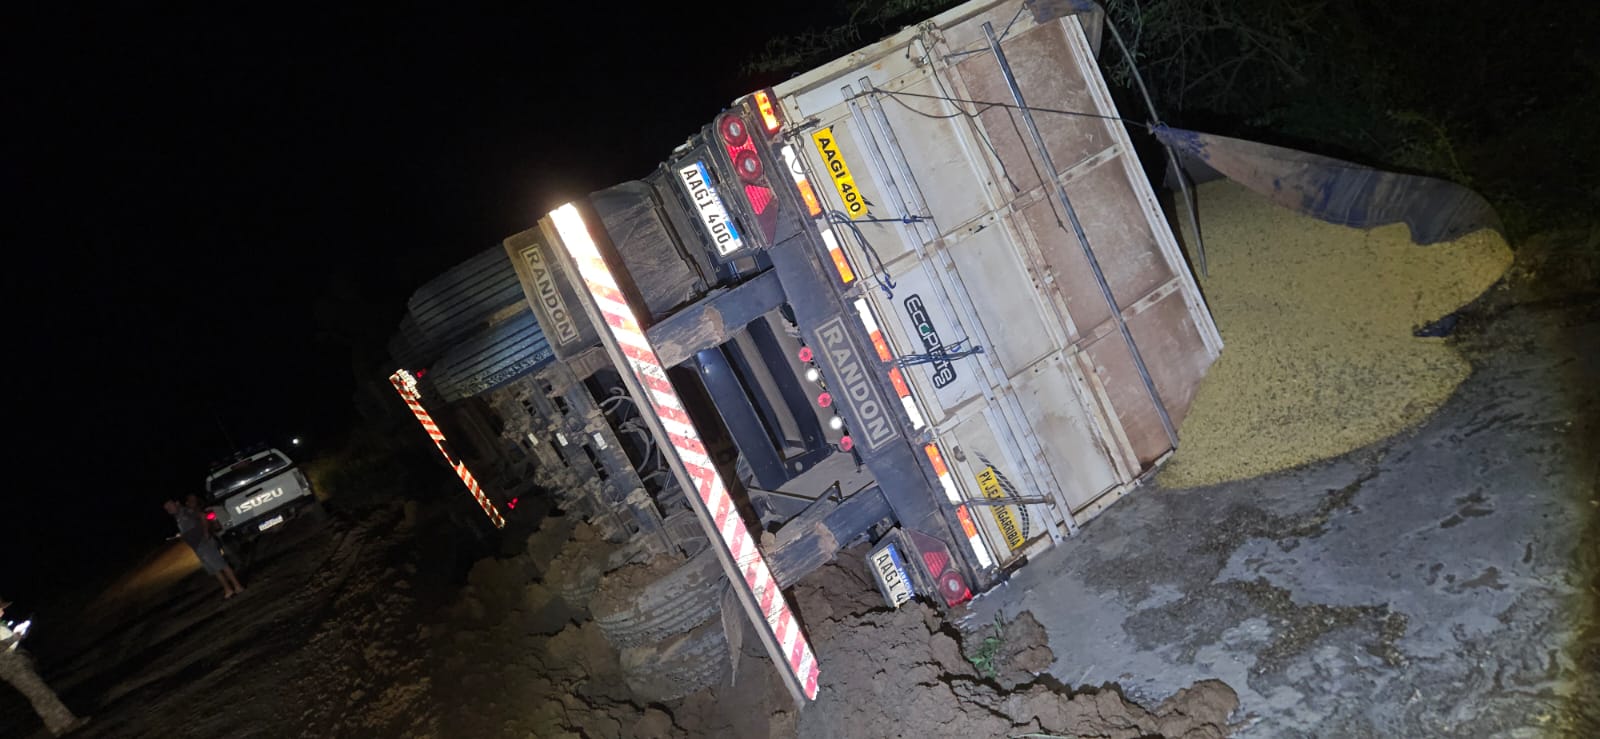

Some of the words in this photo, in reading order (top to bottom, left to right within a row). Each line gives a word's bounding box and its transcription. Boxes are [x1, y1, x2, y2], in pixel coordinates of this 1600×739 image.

[683, 169, 714, 210] AAGI
[708, 214, 731, 244] 400
[819, 138, 846, 178] AAGI
[842, 183, 861, 212] 400
[526, 251, 573, 337] RANDON
[823, 324, 889, 440] RANDON
[235, 487, 284, 514] ISUZU
[992, 495, 1022, 547] TIGARRIBIA
[876, 554, 901, 591] AAGI
